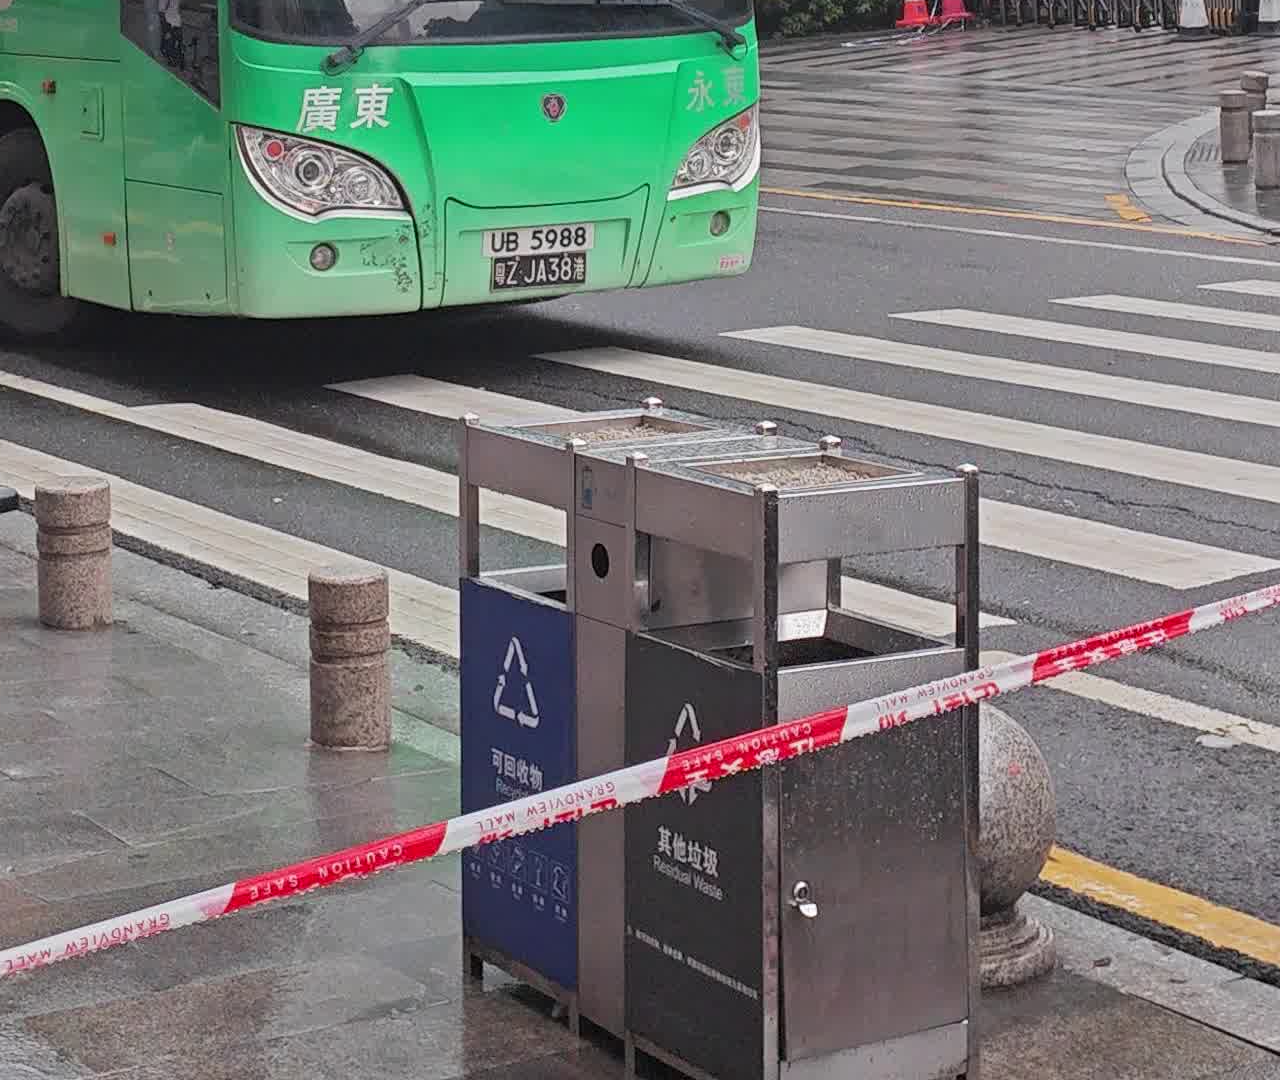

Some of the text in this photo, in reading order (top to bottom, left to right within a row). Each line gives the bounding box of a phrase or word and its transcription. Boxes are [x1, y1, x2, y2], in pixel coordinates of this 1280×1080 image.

[295, 83, 395, 133] 廣東
[685, 67, 748, 113] 永東
[491, 226, 587, 253] UB 5988
[874, 695, 908, 712] MALL
[918, 665, 994, 698] GRANDVIEW
[491, 747, 543, 792] 可回收物
[681, 723, 812, 771] CAUTION SAFE
[475, 812, 515, 831] MALL
[527, 781, 616, 817] GRANDVIEW
[250, 843, 403, 900] CAUTION SAFE
[657, 825, 719, 878] 其他垃圾
[652, 854, 724, 901] Residual Waste
[5, 913, 170, 970] GRANDVIEW MALL
